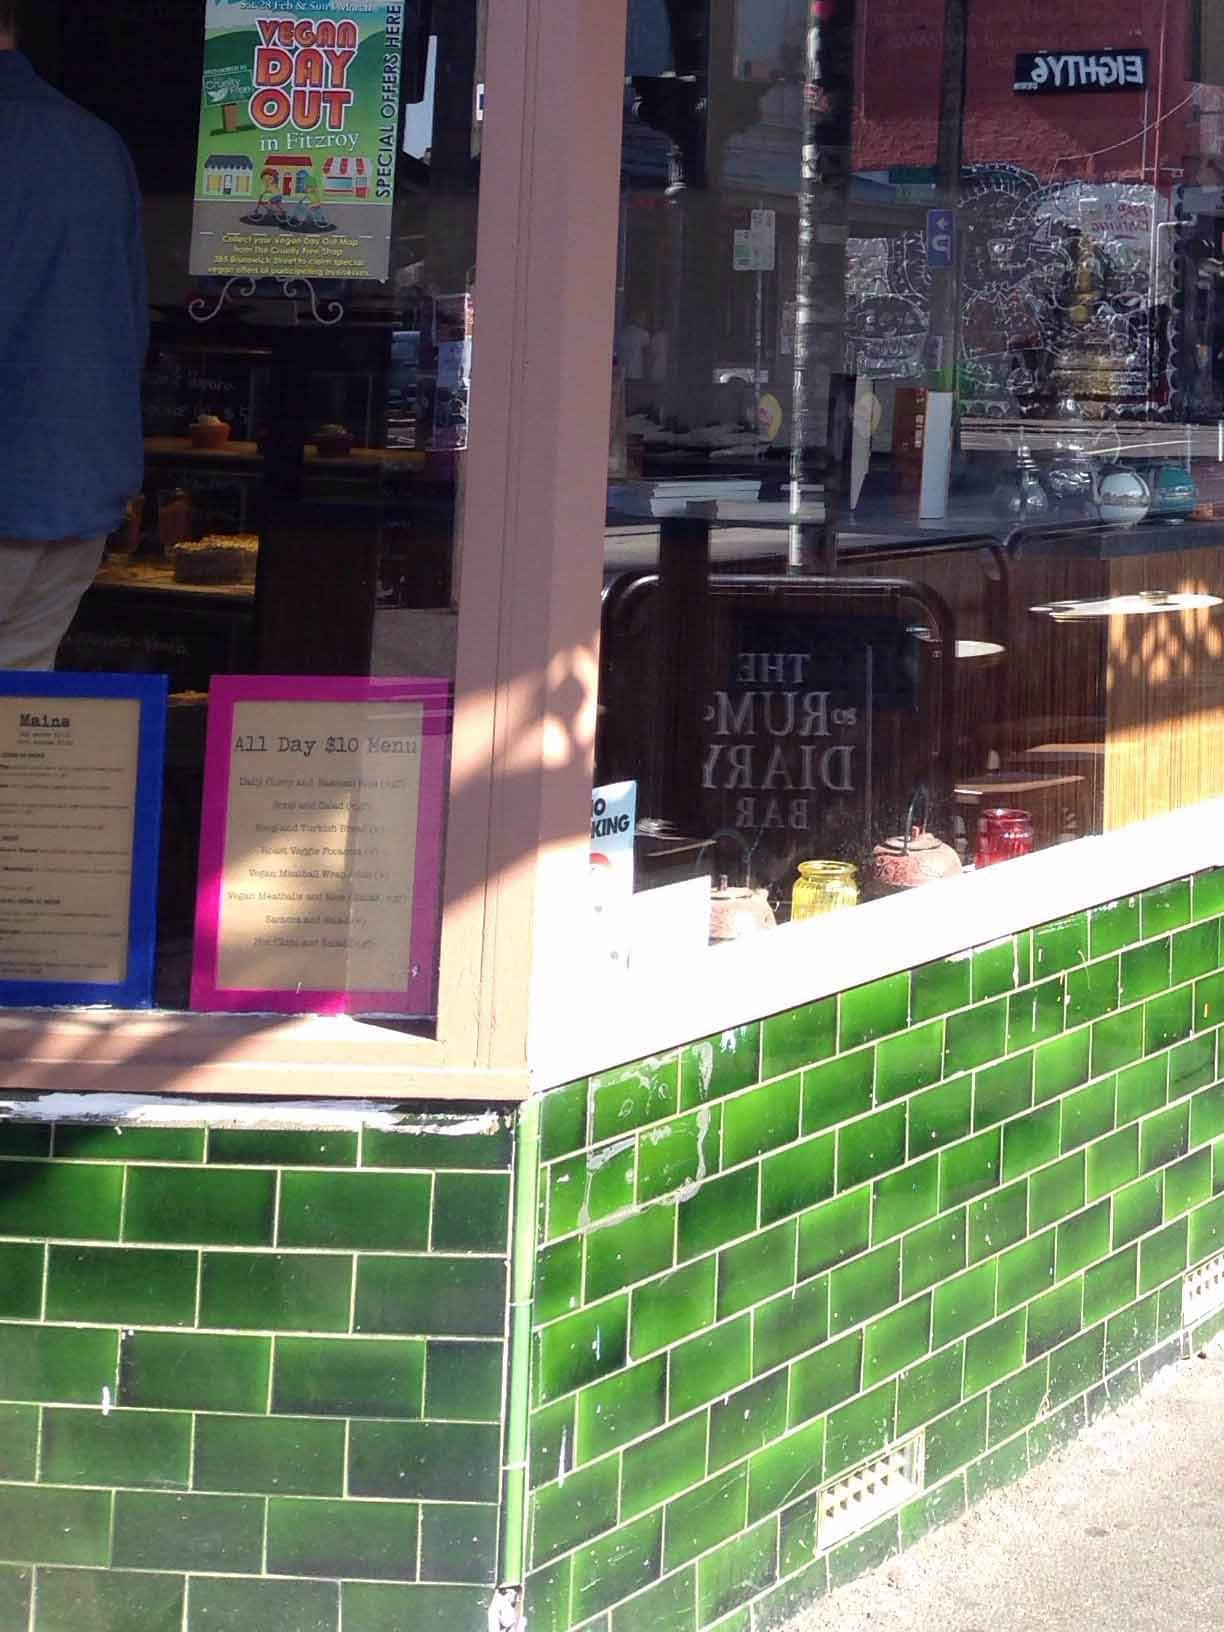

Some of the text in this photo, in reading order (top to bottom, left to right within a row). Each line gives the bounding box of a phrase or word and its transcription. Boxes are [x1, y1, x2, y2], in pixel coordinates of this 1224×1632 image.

[256, 19, 358, 50] VEGAN
[254, 48, 357, 89] DAY
[249, 87, 353, 131] OUT
[375, 4, 402, 198] SPECIAL OFFERS HERE
[260, 132, 359, 151] in Fitzroy
[19, 714, 70, 728] Mains
[234, 736, 418, 756] All Day $10 Menu
[592, 814, 630, 839] KING
